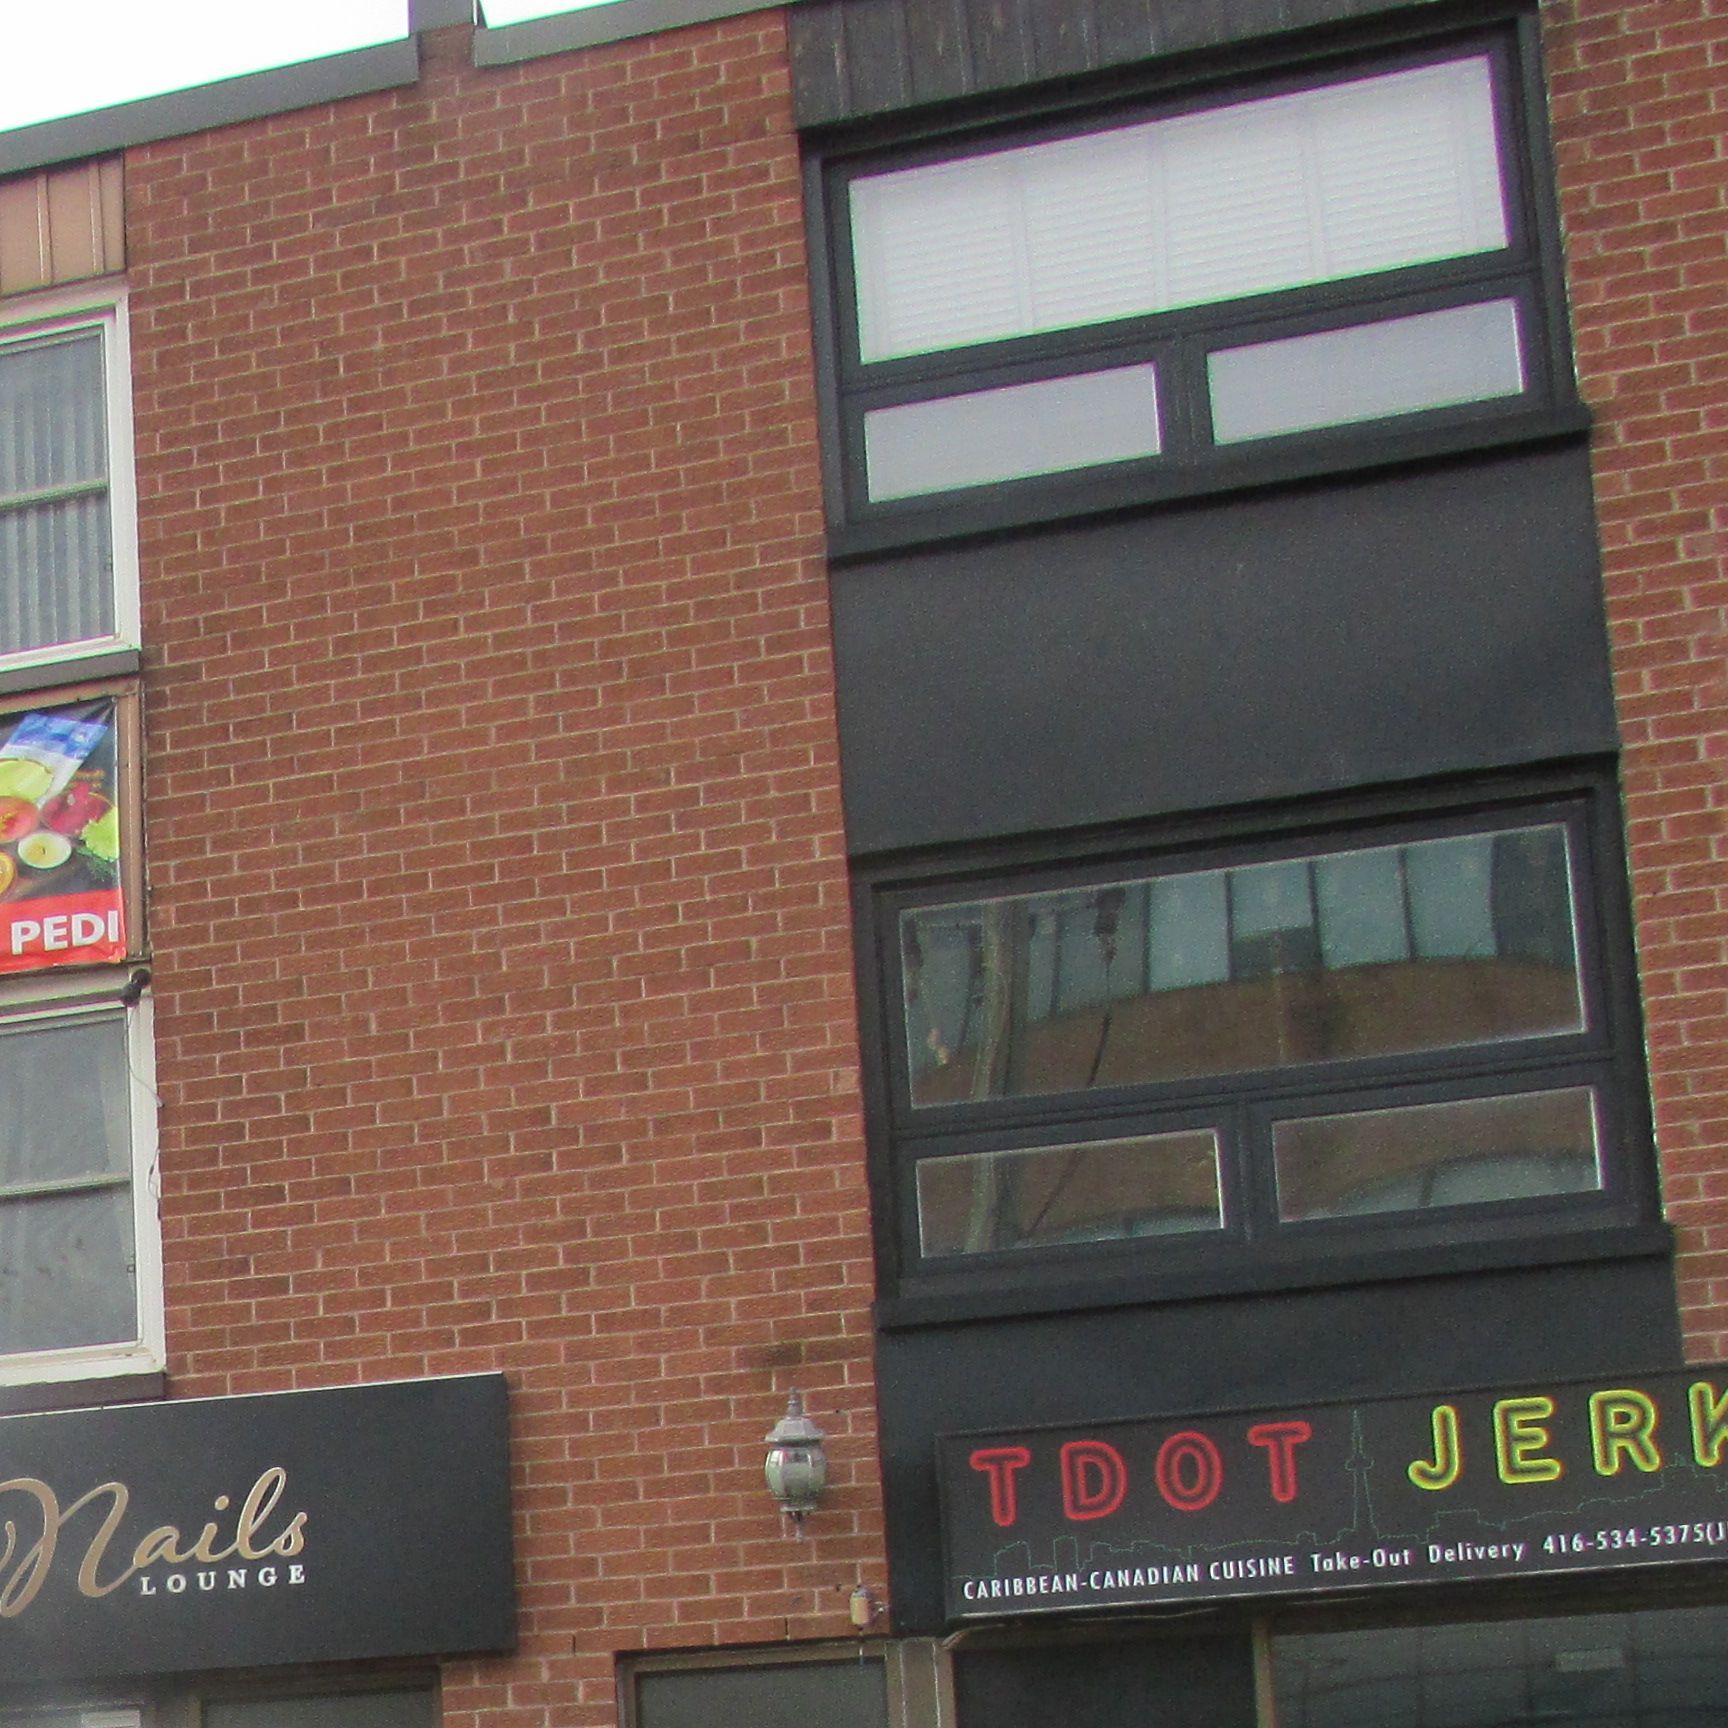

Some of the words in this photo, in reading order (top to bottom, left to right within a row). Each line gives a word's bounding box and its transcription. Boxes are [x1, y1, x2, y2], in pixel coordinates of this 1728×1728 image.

[10, 910, 120, 957] PEDI
[139, 1563, 307, 1597] LOUNGE
[962, 1563, 1200, 1600] CARIBBEAN-CANADIAN
[1209, 1555, 1295, 1581] CUISINE
[1310, 1548, 1411, 1573] Take-Out
[1428, 1542, 1525, 1561] Delivery
